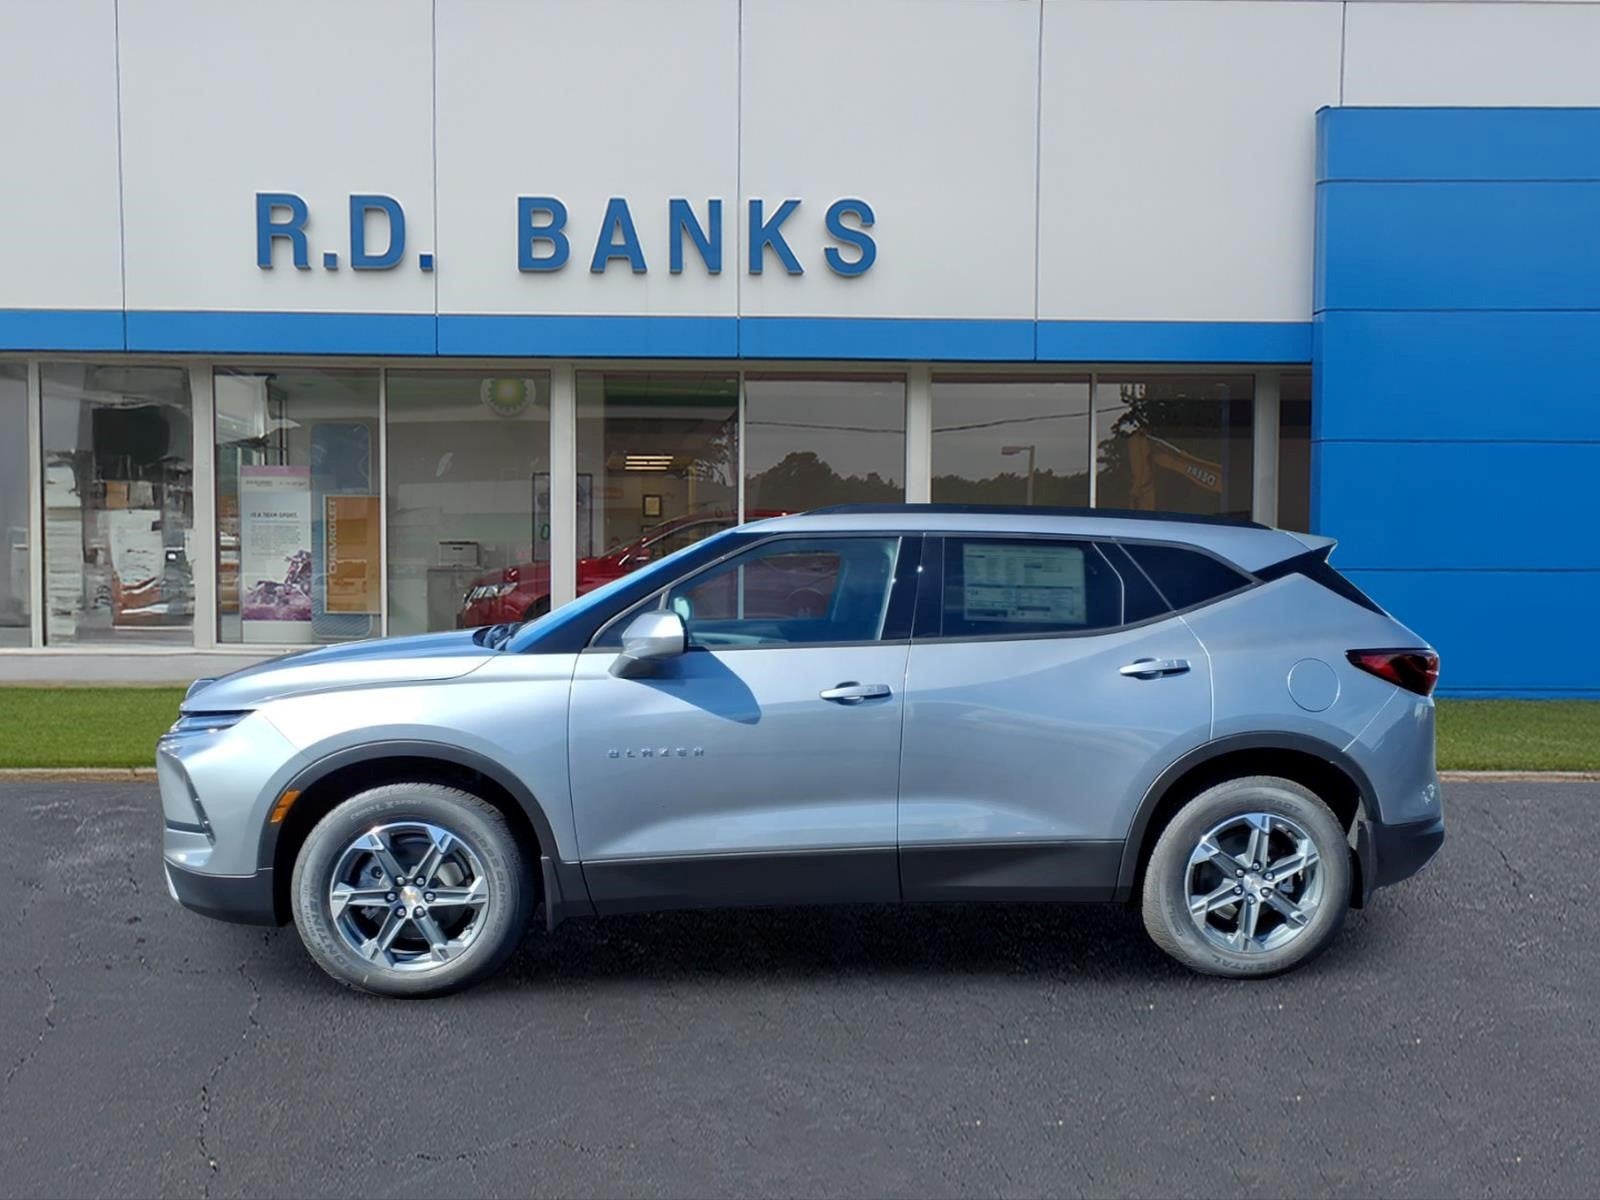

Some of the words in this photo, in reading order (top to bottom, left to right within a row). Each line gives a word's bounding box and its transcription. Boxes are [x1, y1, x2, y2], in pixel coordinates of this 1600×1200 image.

[256, 192, 434, 272] R.D.
[517, 195, 877, 278] BANKS
[327, 498, 337, 575] CHEVROLET
[607, 747, 704, 759] BLAZER
